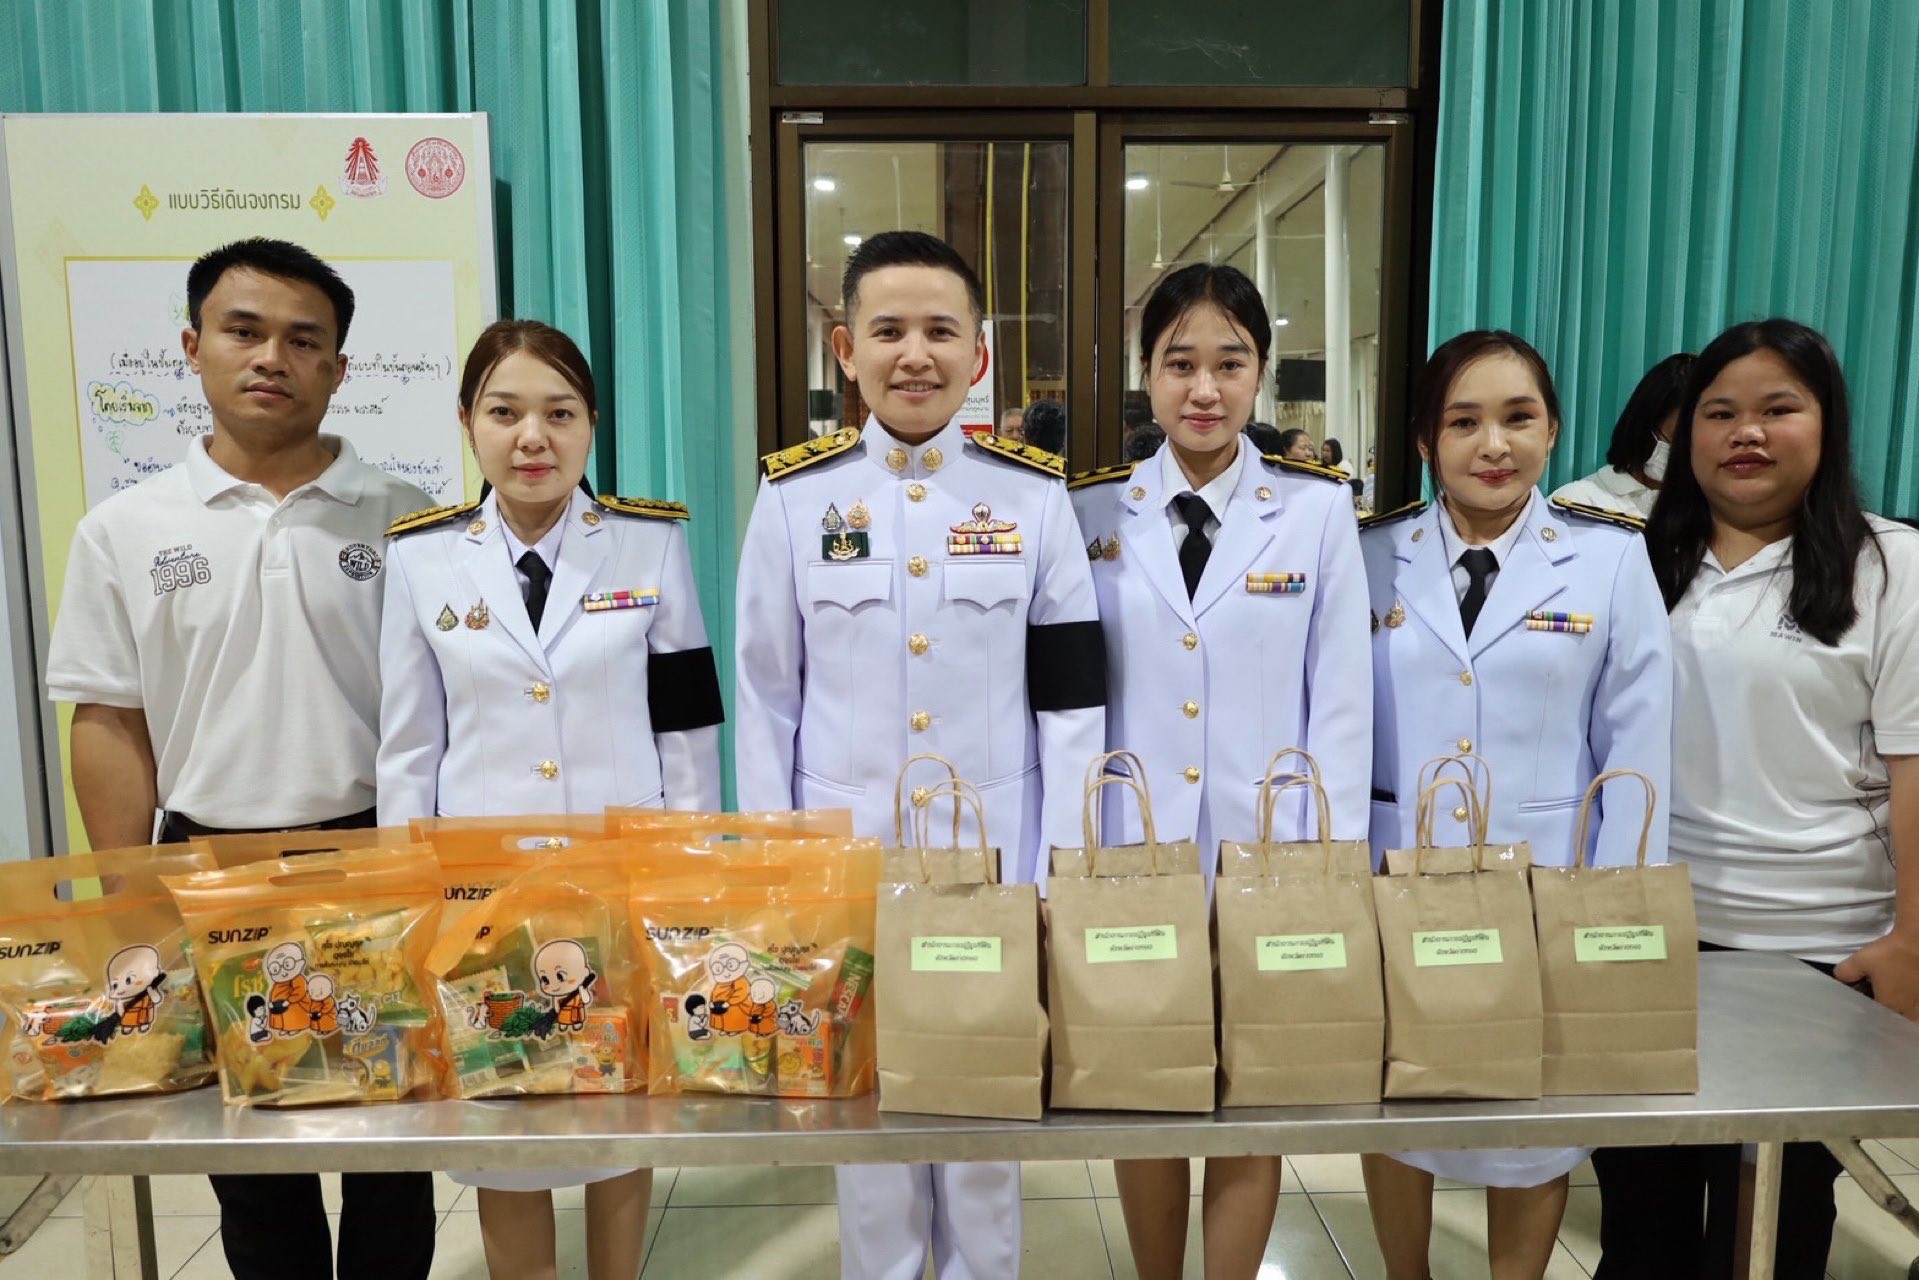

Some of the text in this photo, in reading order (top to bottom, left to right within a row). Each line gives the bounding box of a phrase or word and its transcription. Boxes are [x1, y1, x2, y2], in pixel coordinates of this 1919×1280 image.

[169, 187, 301, 209] แบบวิธีเดินจงกรม
[150, 556, 212, 596] 1996
